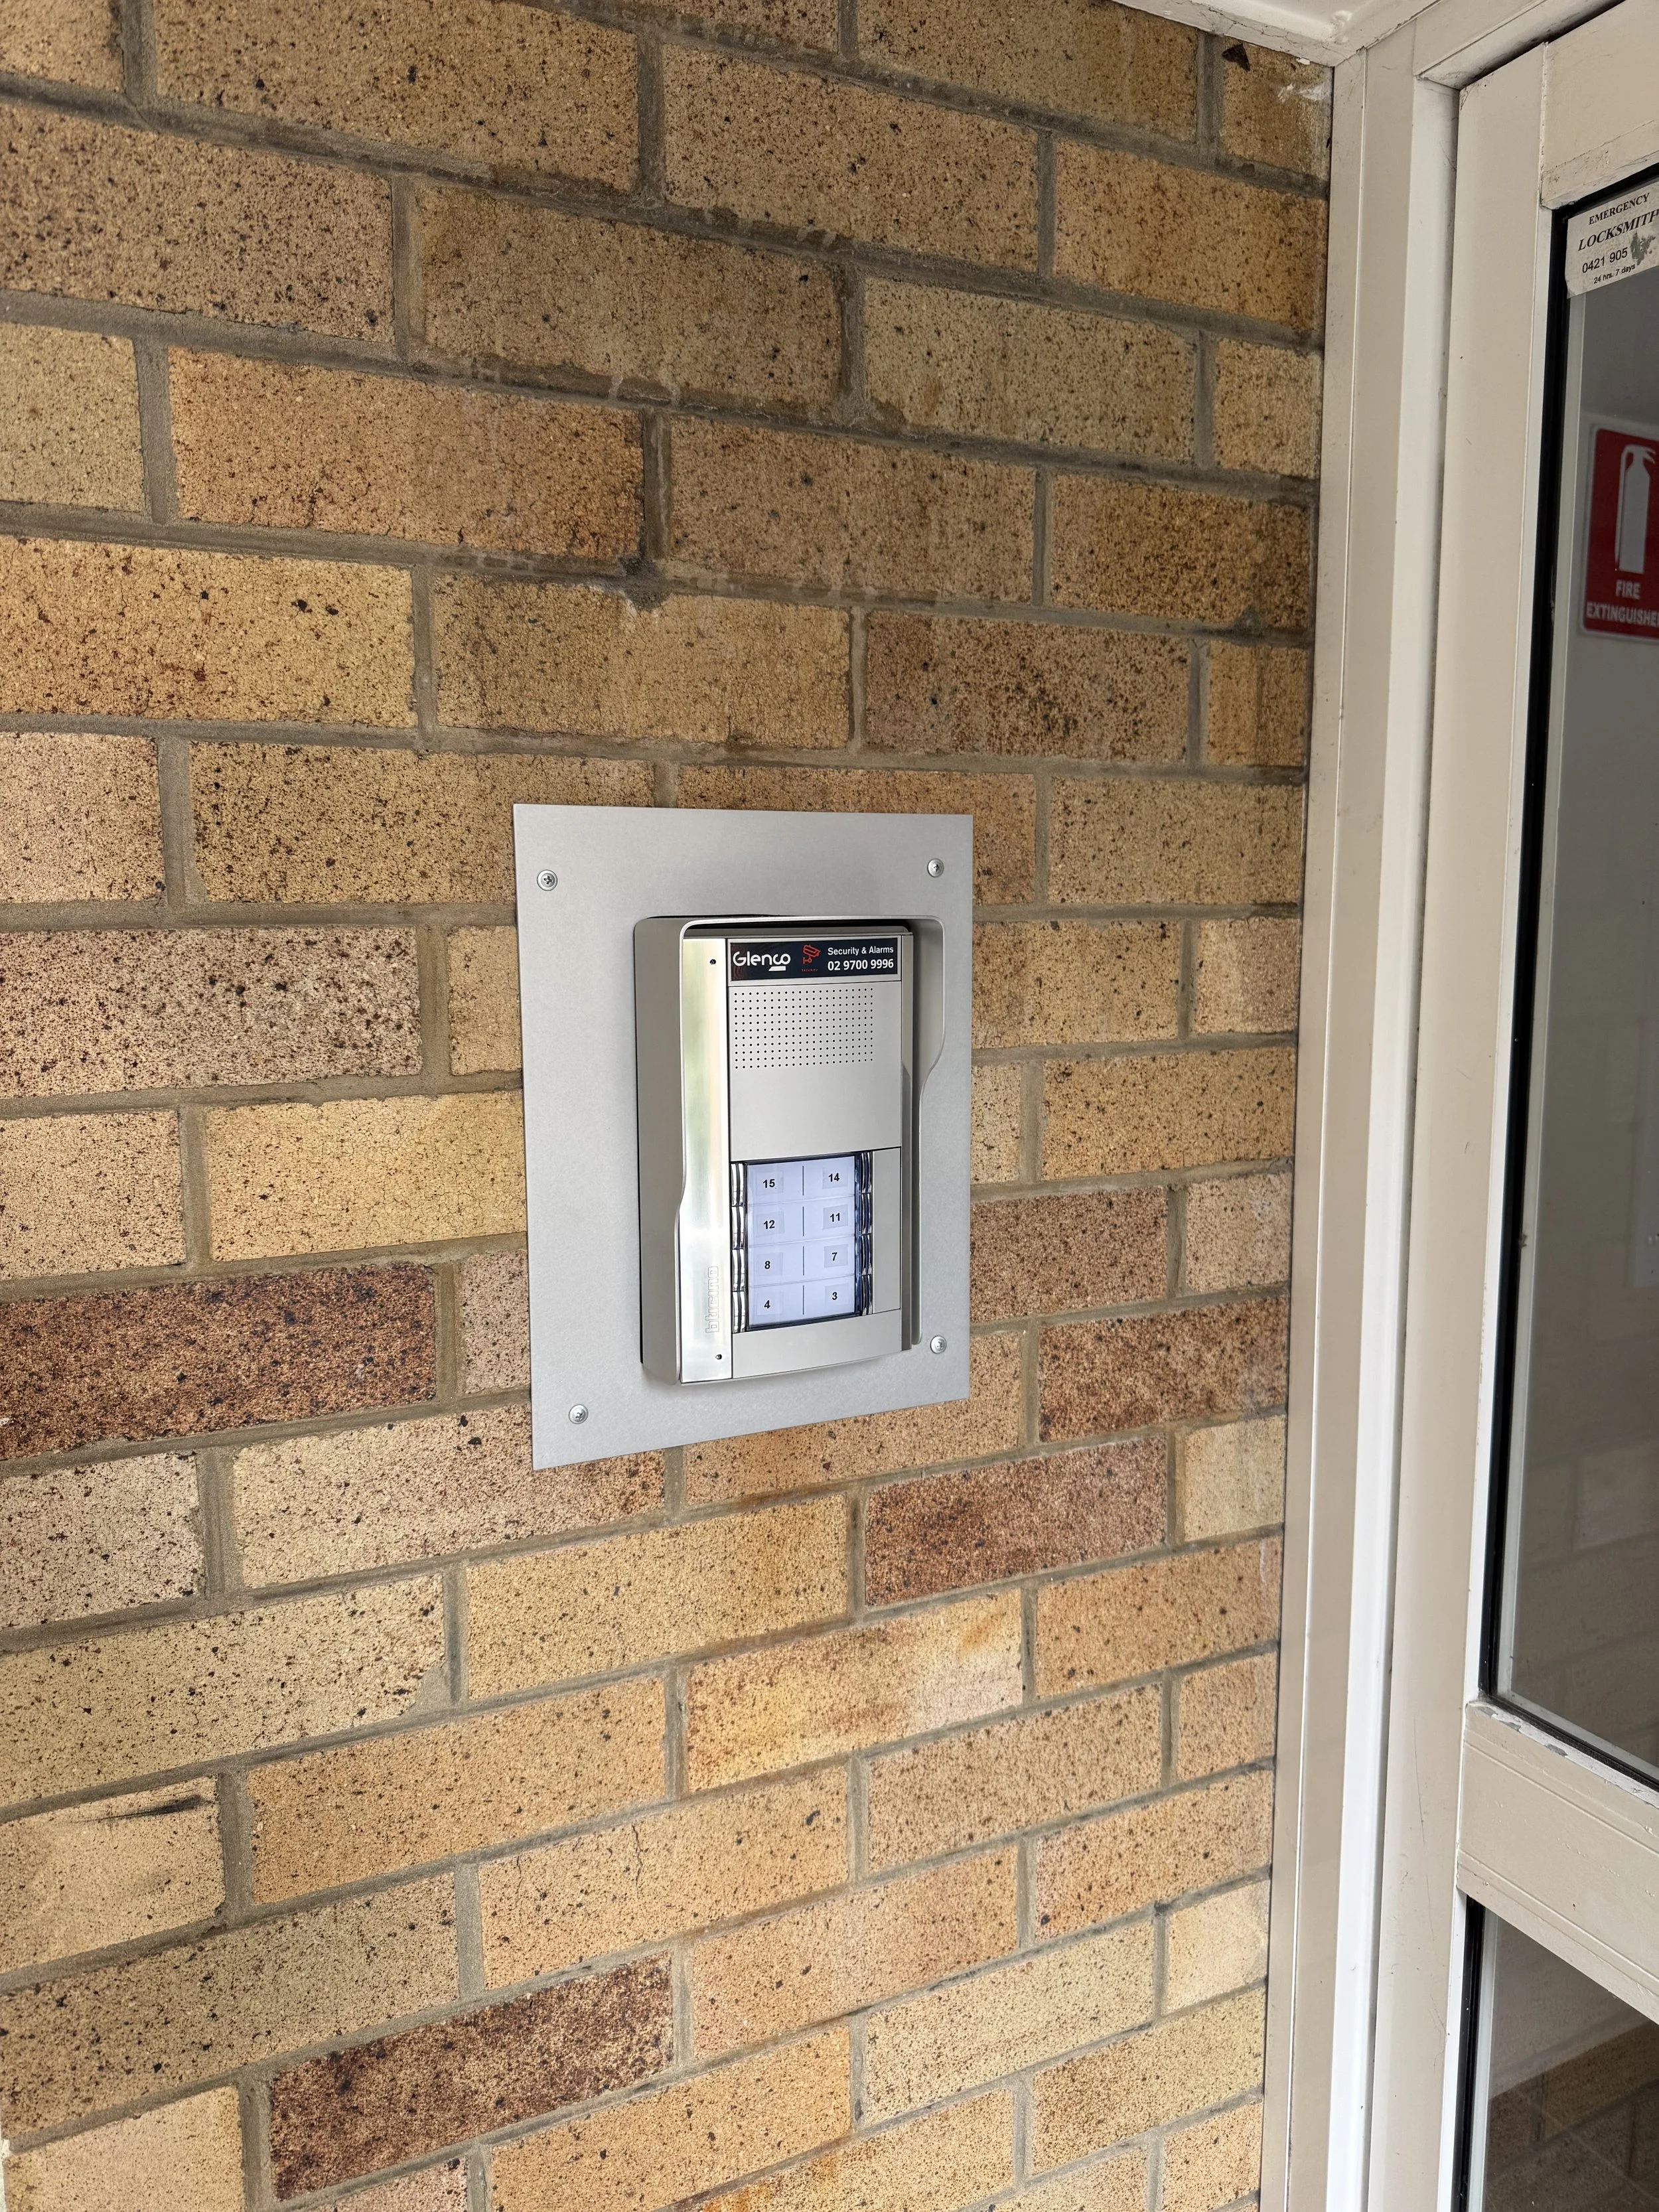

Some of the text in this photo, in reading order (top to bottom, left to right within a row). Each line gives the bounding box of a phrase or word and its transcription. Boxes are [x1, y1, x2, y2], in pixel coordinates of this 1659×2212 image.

[1588, 192, 1650, 225] EMERGENCY
[1577, 208, 1659, 252] LOCKSMITH
[1582, 247, 1628, 273] 0421 905
[1593, 275, 1601, 284] 24
[1621, 263, 1636, 274] days
[1615, 579, 1641, 600] FIRE
[1586, 601, 1659, 628] EXTINGUISHE
[828, 945, 894, 956] Security & Alarms
[732, 950, 791, 966] Glenco
[828, 958, 894, 971] 02 9700 9996
[828, 1173, 840, 1182] 14
[762, 1179, 775, 1189] 15
[830, 1213, 840, 1222] 11
[763, 1220, 775, 1230] 12
[831, 1252, 837, 1261] 7
[764, 1260, 770, 1270] 8
[705, 1266, 719, 1333] bticino
[832, 1291, 837, 1300] 3
[764, 1300, 770, 1309] 4
